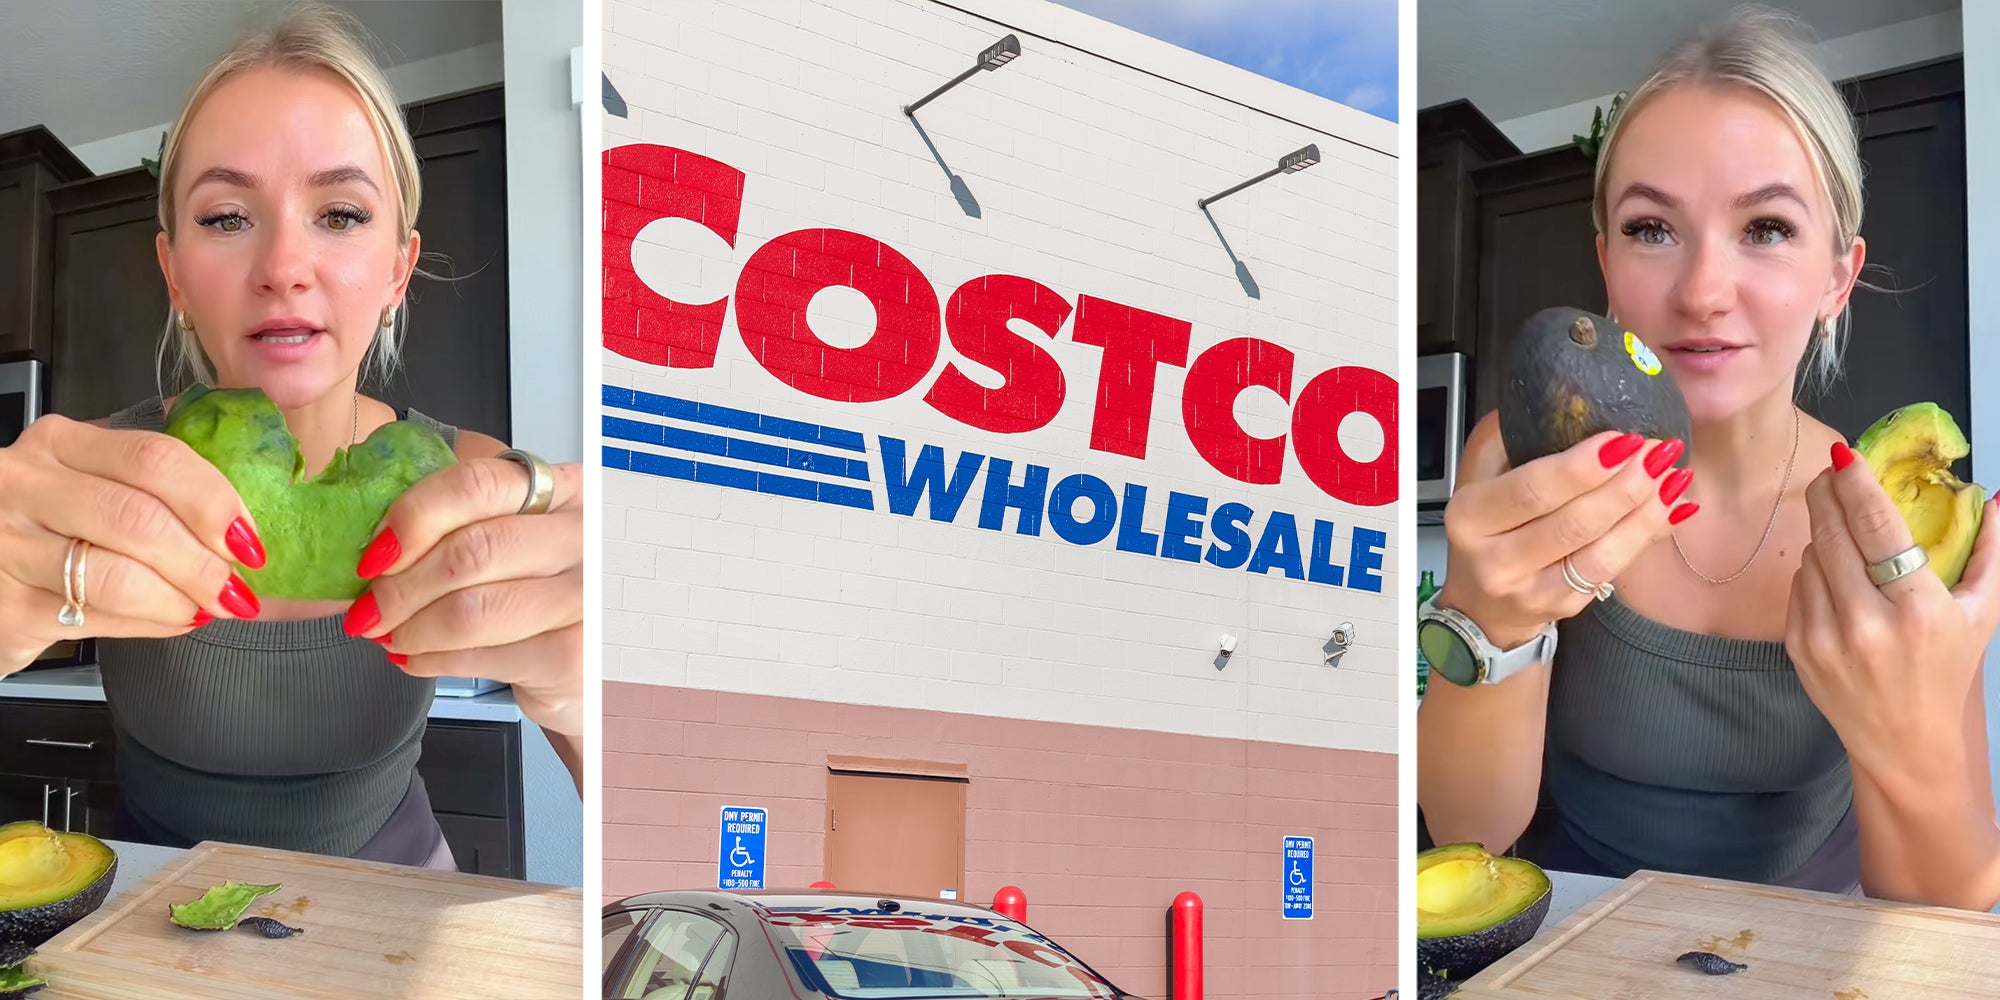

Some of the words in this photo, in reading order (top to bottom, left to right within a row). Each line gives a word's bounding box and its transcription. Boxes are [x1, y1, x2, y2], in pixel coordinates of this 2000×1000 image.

[602, 143, 1399, 506] COSTCO
[877, 435, 1386, 592] WHOLESALE
[740, 811, 764, 823] PERMIT
[727, 823, 760, 834] REQUIRED
[1287, 849, 1309, 859] REQUIRED
[731, 869, 753, 878] PENALTY
